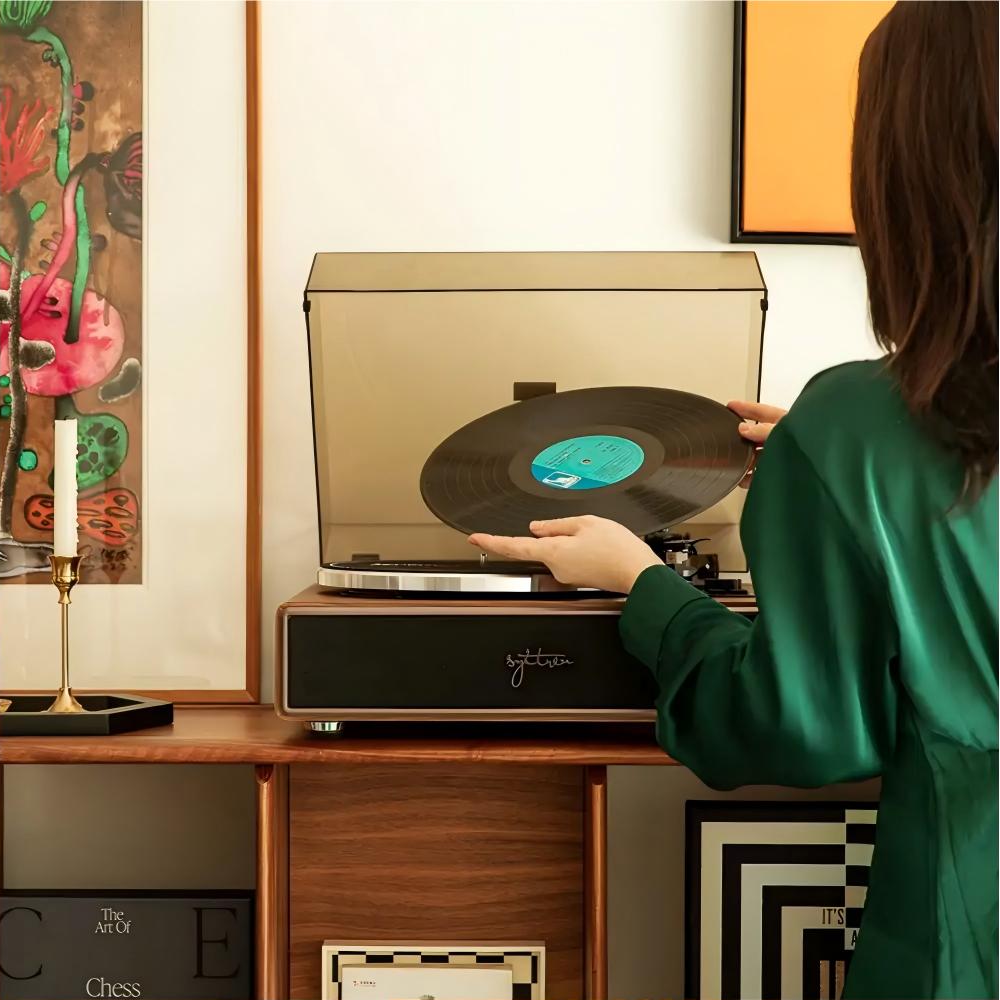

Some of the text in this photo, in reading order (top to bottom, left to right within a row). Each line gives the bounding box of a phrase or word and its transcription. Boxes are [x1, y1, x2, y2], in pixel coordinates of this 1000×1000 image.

[101, 908, 124, 921] The
[822, 908, 844, 925] IT'S
[95, 920, 131, 934] Art Of
[192, 907, 240, 979] E
[86, 977, 141, 998] Chess
